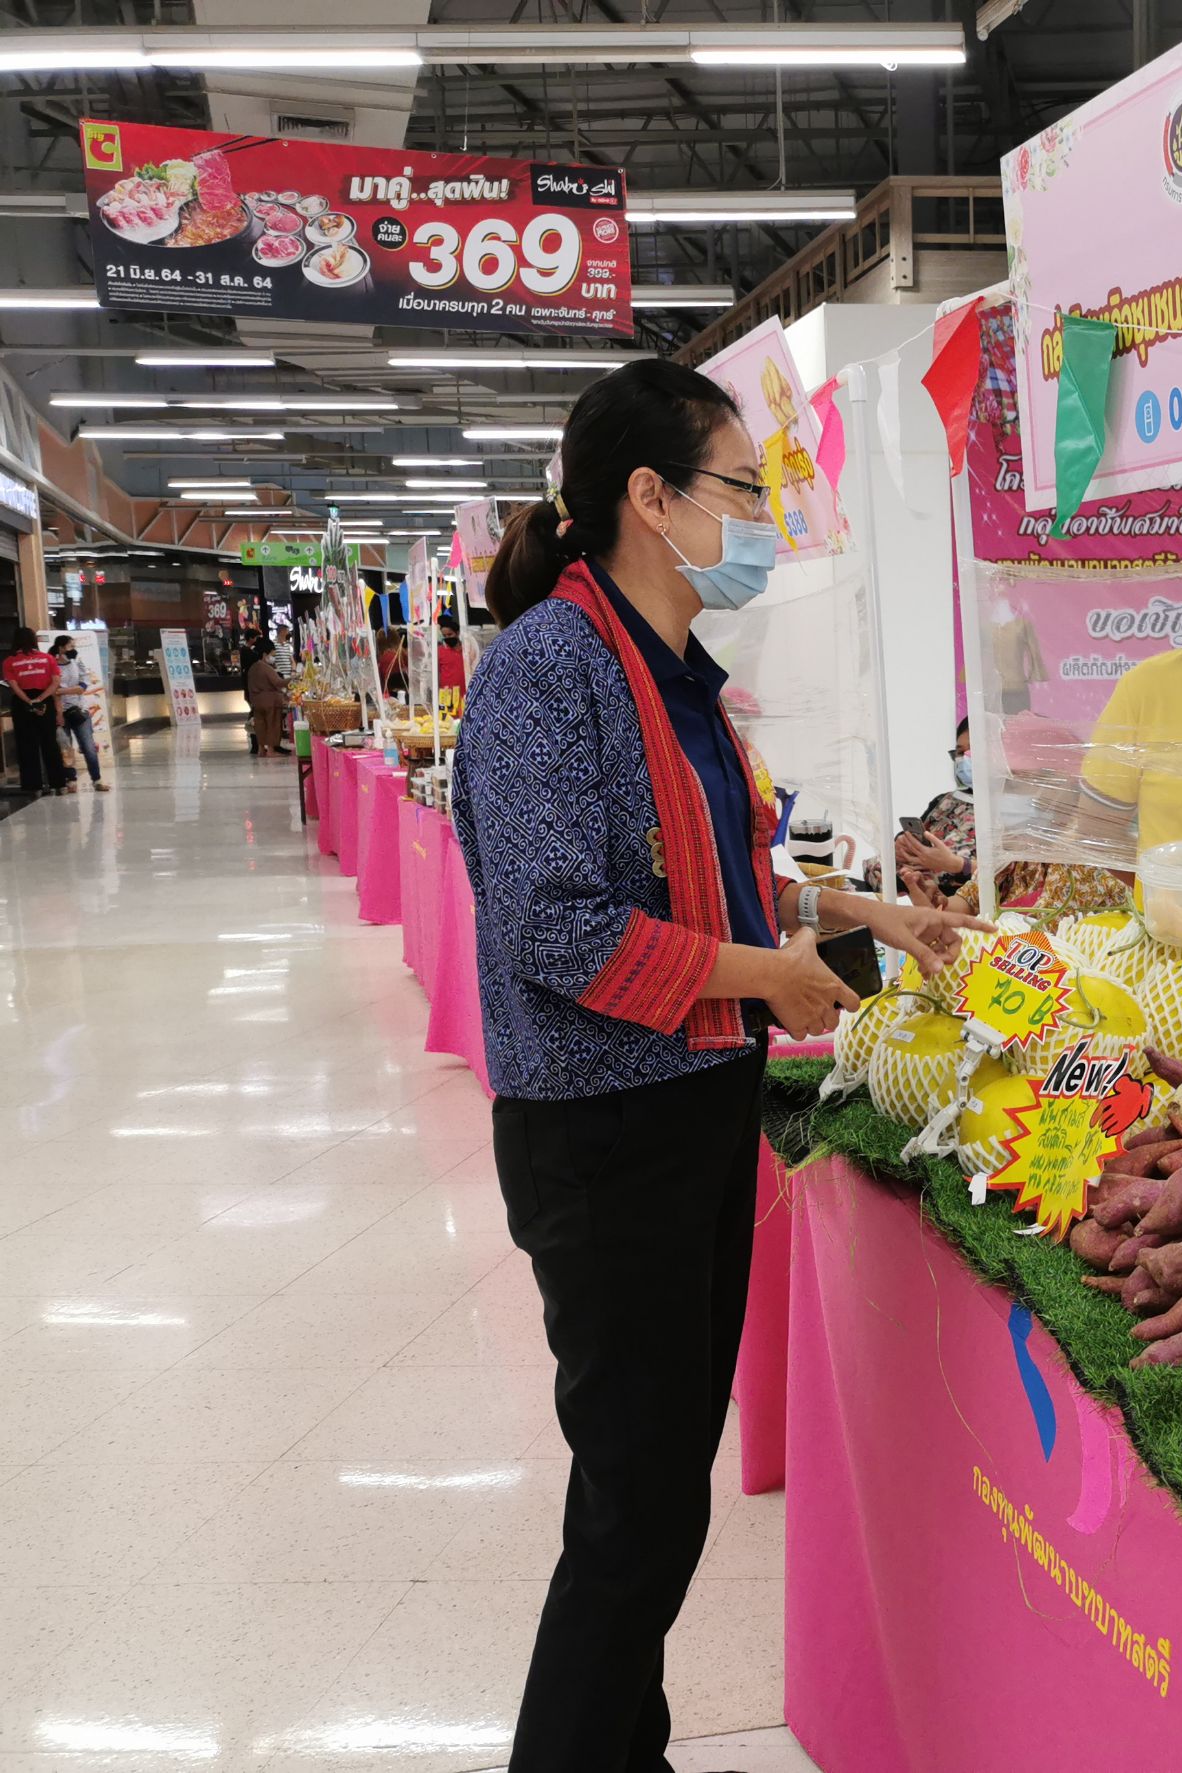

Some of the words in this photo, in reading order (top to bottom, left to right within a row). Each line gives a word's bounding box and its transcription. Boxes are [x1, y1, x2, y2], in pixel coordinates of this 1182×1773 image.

[377, 233, 403, 242] คนละ
[379, 220, 401, 234] จ่าย
[408, 213, 582, 296] 369
[106, 264, 125, 278] 21
[160, 268, 182, 282] 64
[252, 276, 273, 289] 64
[581, 282, 616, 299] บาท
[398, 291, 488, 317] เมื่อมาครบทุก
[490, 298, 504, 315] 2
[505, 303, 526, 316] คน
[208, 602, 227, 619] 369
[1005, 937, 1054, 972] TOP
[1039, 1037, 1131, 1099] New!
[972, 1465, 1171, 1698] กองทุนพัฒนาบทบาทสตรี
